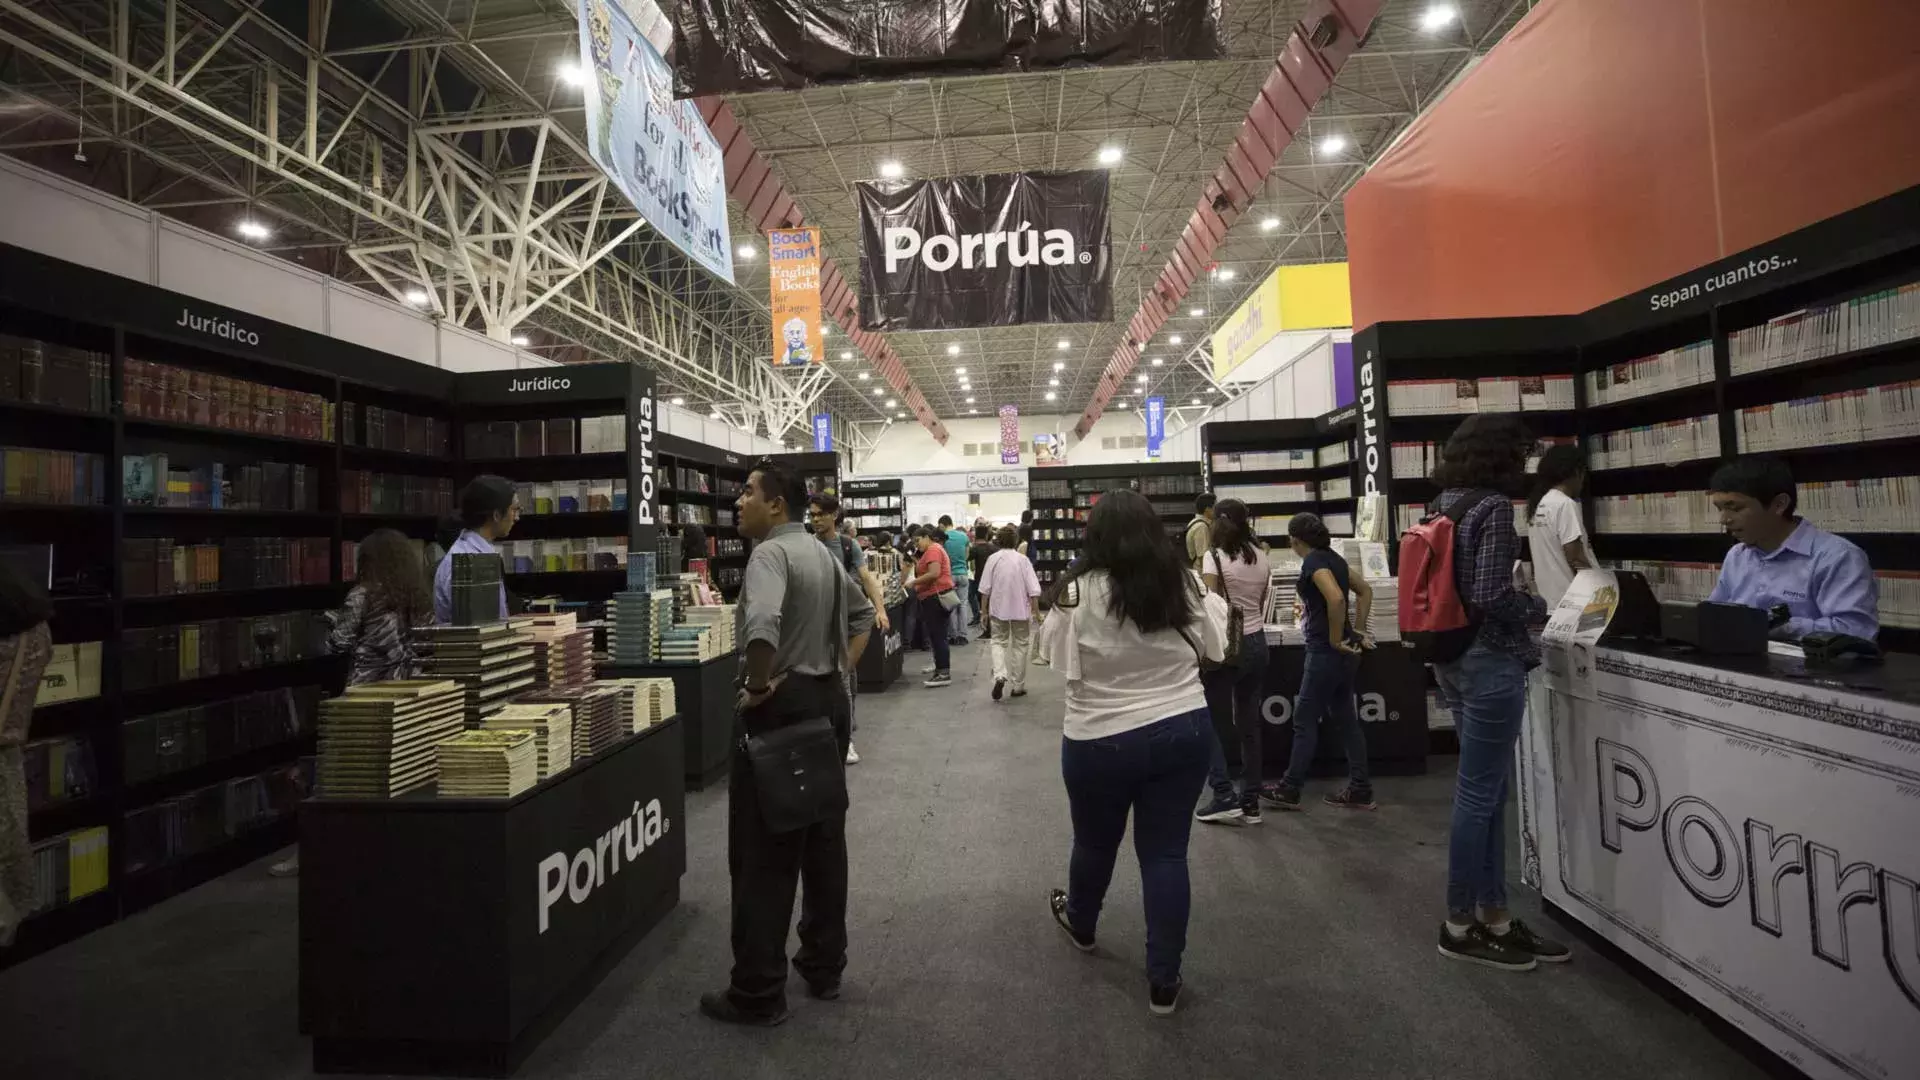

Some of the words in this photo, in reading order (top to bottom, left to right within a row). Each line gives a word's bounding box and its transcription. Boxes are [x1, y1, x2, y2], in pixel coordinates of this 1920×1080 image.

[771, 230, 812, 245] Book
[772, 246, 816, 261] Smart
[771, 263, 820, 281] English
[780, 279, 820, 292] Books
[1649, 282, 1701, 314] Sepan
[1704, 255, 1799, 293] cuantos...
[176, 307, 261, 348] Jurídico
[507, 373, 572, 393] Jurídico
